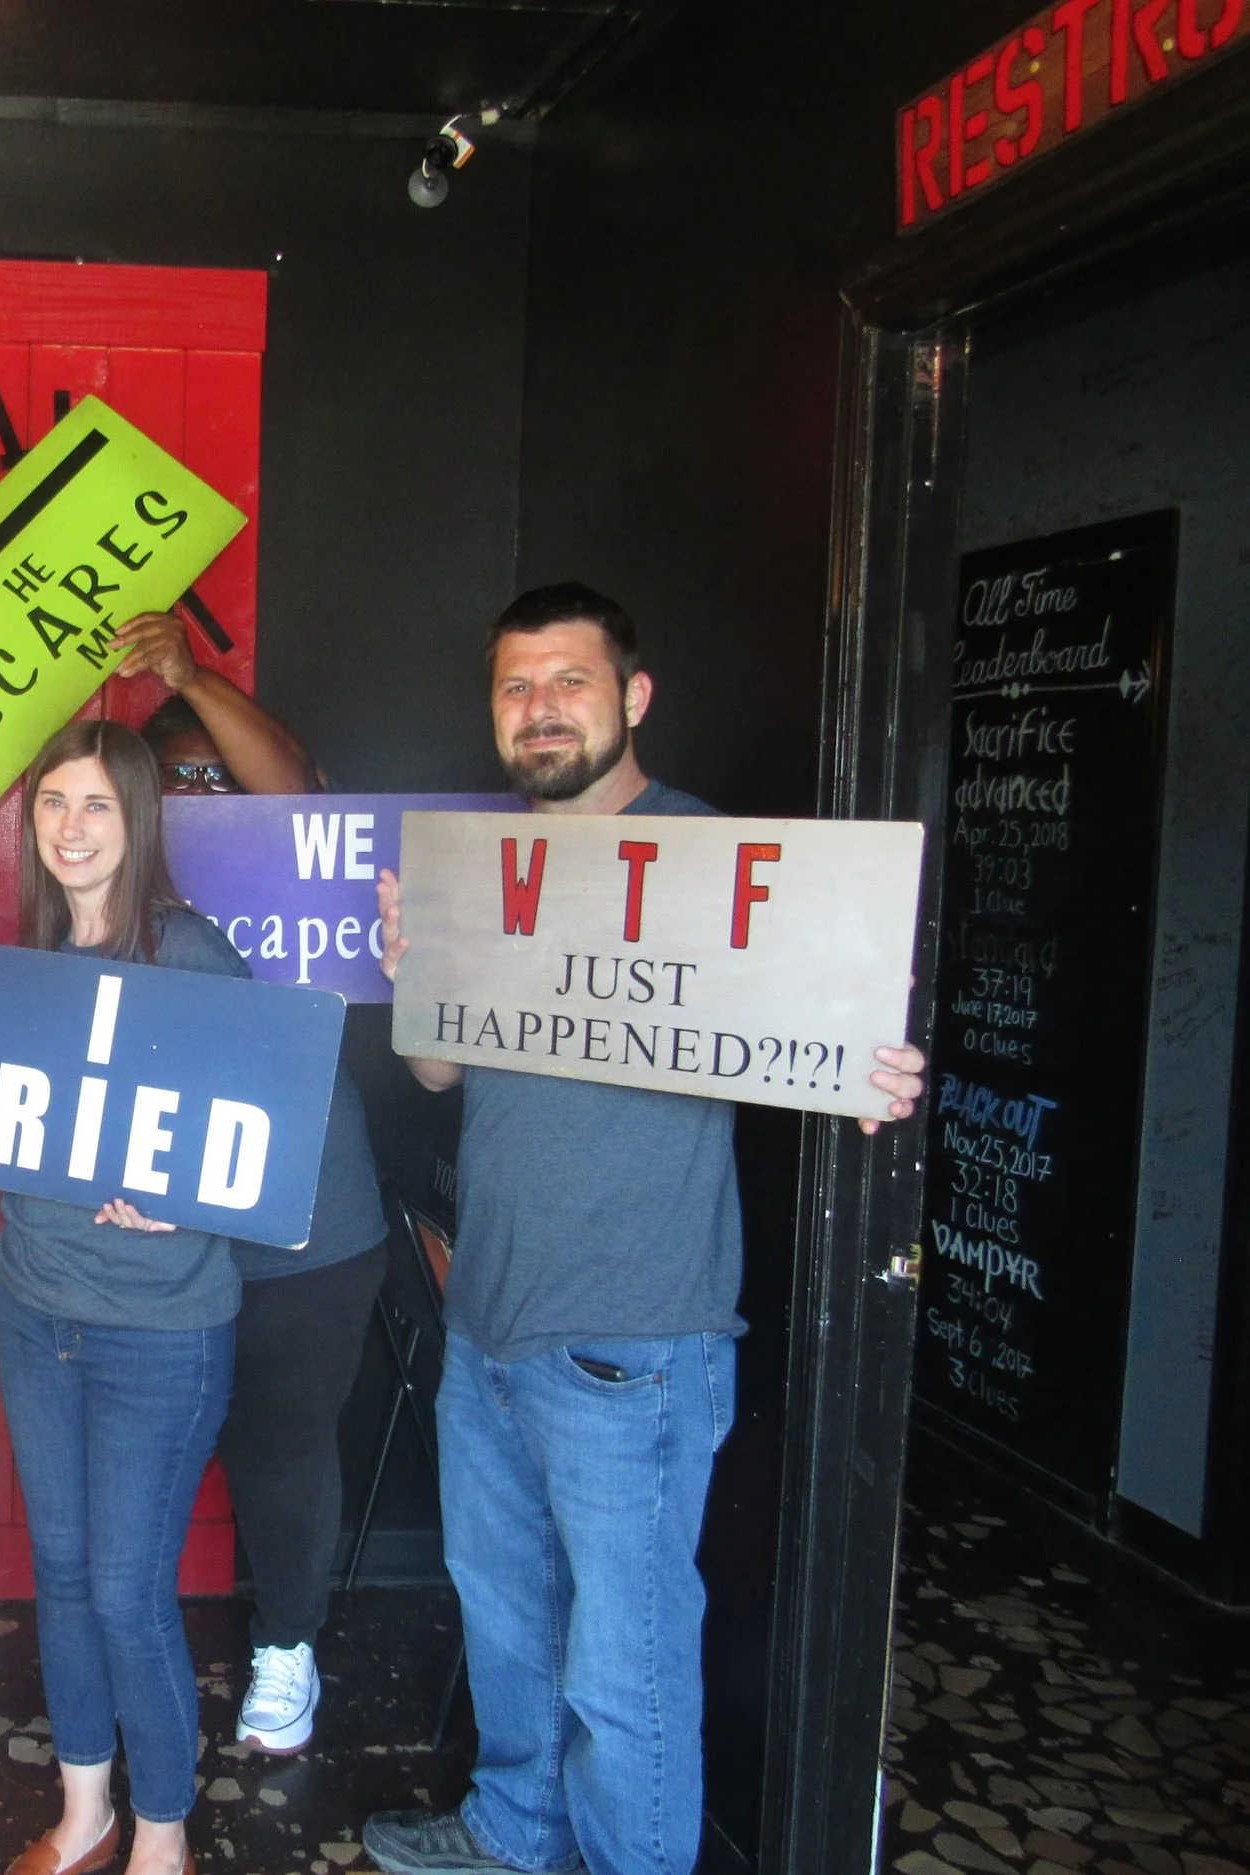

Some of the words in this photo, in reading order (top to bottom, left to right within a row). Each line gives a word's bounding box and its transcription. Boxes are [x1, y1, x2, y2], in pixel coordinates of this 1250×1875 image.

[2, 553, 56, 603] HE
[963, 575, 1015, 626] All
[1014, 567, 1079, 618] Time
[963, 705, 1080, 761] Sacrifice
[954, 763, 1073, 816] advanced
[293, 813, 376, 880] WE
[972, 854, 1031, 890] 39:03
[986, 889, 1027, 915] Clue
[555, 953, 697, 1007] JUST
[951, 990, 983, 1018] June
[971, 967, 1034, 1006] 37:19
[87, 974, 123, 1065] I
[434, 1002, 846, 1091] HAPPENED?!?!
[964, 1028, 976, 1050] 0
[980, 1031, 1034, 1066] Clues
[951, 1159, 1019, 1213] 32:18
[965, 1202, 1019, 1245] Clues
[947, 1272, 1014, 1335] 34:04
[948, 1356, 965, 1389] 3
